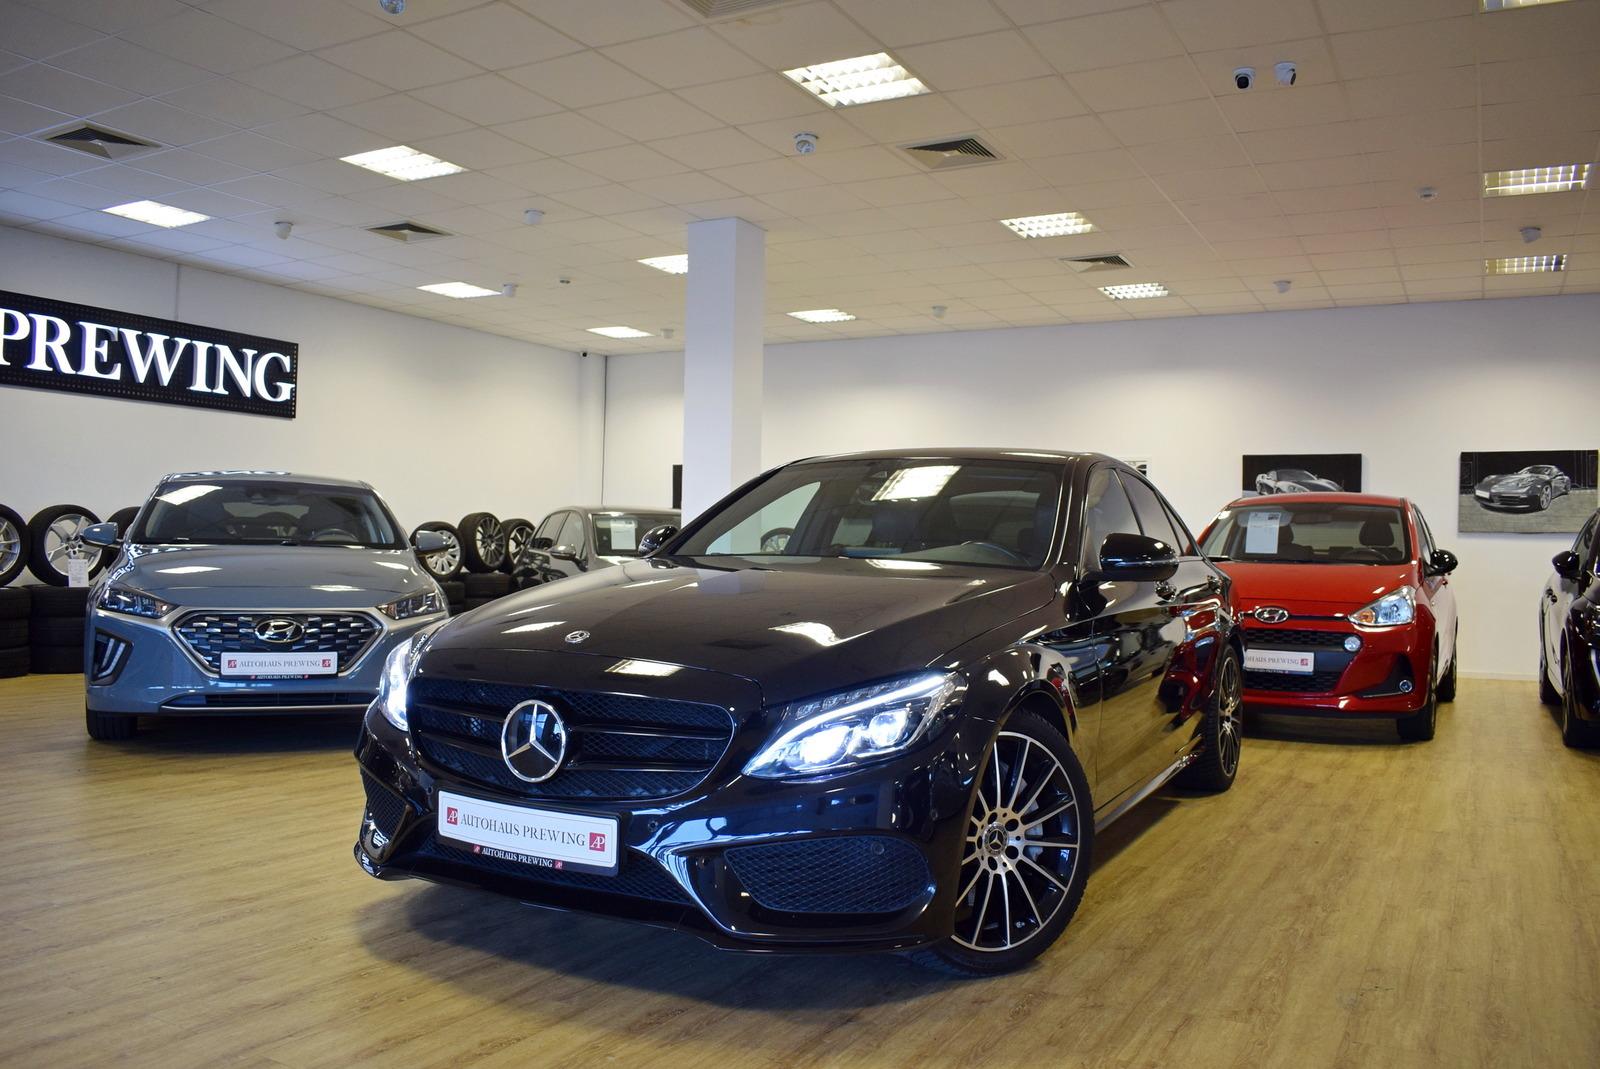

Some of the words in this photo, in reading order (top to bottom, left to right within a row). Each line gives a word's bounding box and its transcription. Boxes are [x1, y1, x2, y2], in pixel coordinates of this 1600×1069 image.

[0, 307, 296, 402] PREWING
[239, 660, 281, 668] AUTOHAUS
[283, 659, 320, 667] PREWING
[460, 813, 520, 837] AUTOHAUS
[522, 825, 586, 847] PREWING
[481, 847, 518, 862] AUTOHAUS
[517, 854, 553, 868] PREWING
